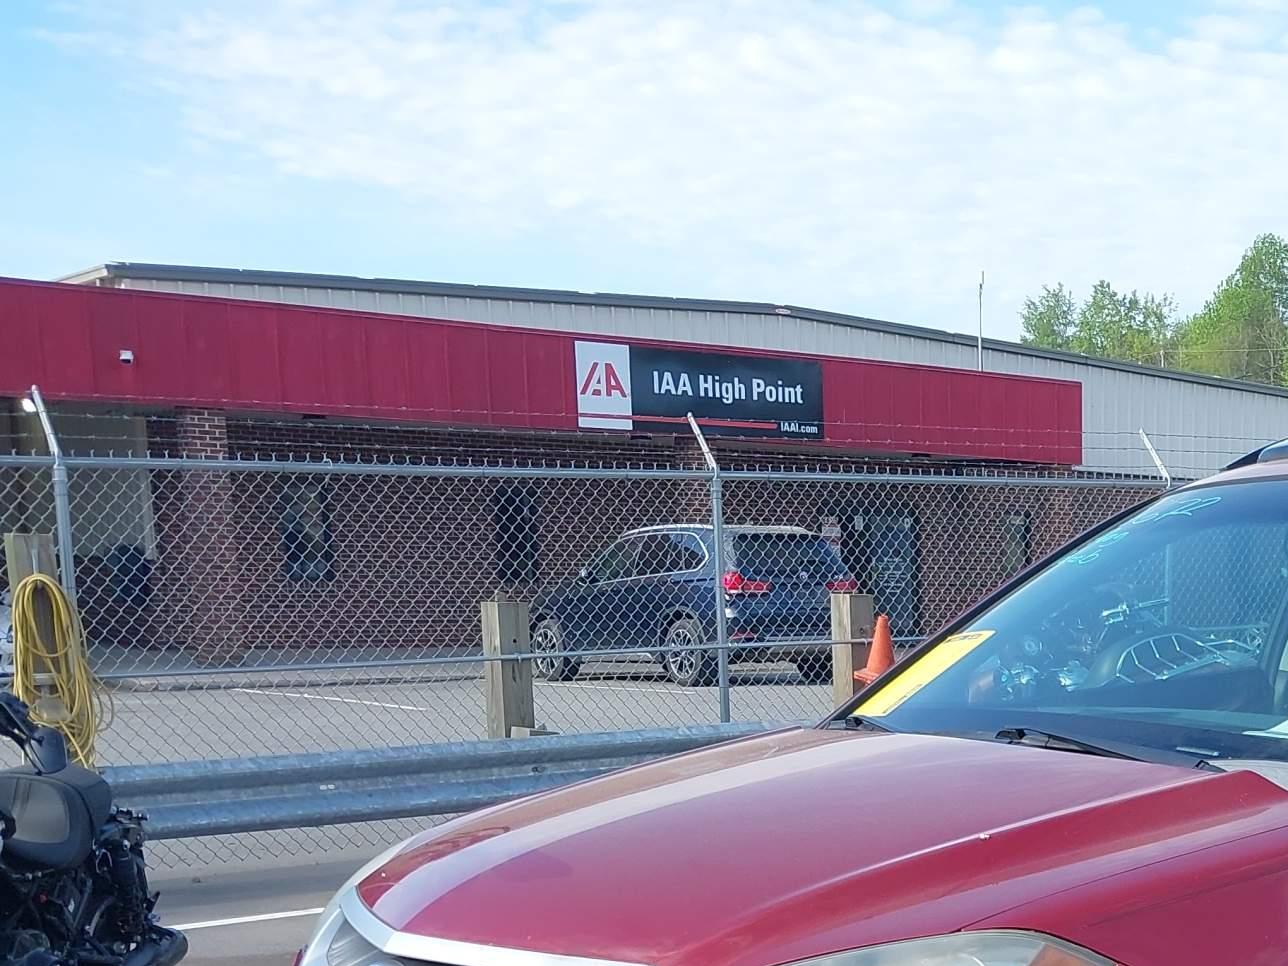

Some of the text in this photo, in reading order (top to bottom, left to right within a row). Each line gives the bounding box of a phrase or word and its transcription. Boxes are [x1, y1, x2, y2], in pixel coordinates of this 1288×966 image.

[652, 370, 804, 404] IAA High Point
